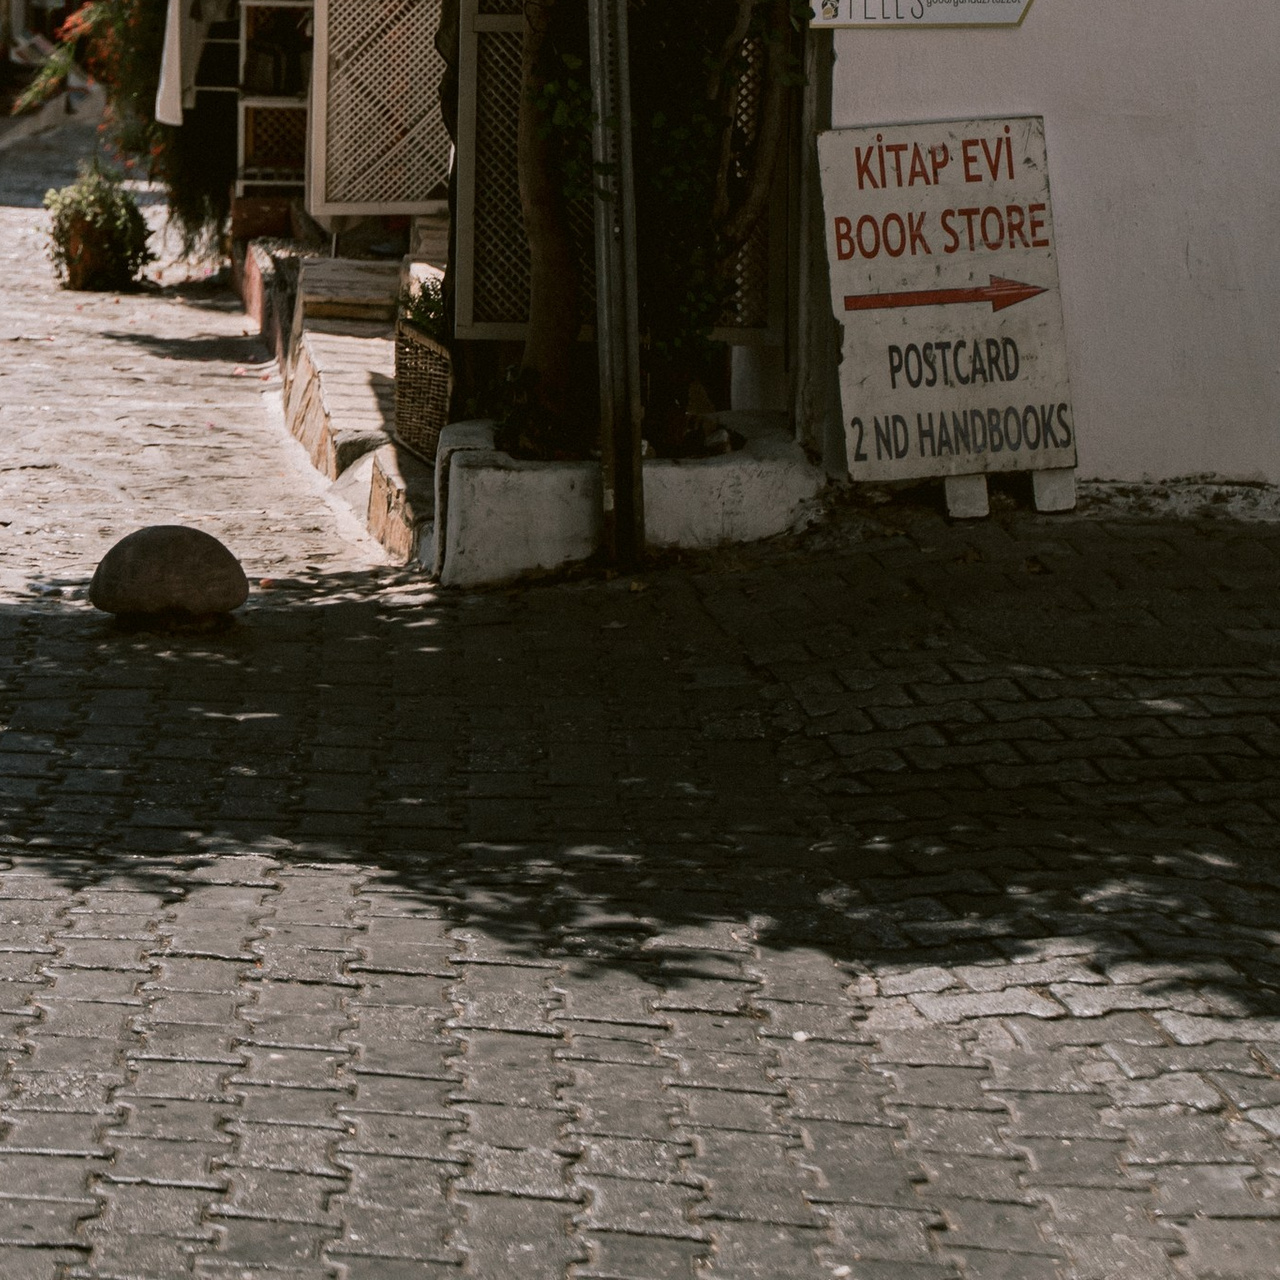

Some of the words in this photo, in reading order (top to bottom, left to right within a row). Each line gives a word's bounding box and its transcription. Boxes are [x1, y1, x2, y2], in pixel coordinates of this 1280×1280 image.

[855, 133, 950, 190] KİTAP
[962, 125, 1015, 185] EVİ
[834, 211, 933, 261] BOOK
[940, 203, 1050, 254] STORE
[888, 337, 1020, 389] POSTCARD
[916, 403, 1073, 458] HANDBOOKS
